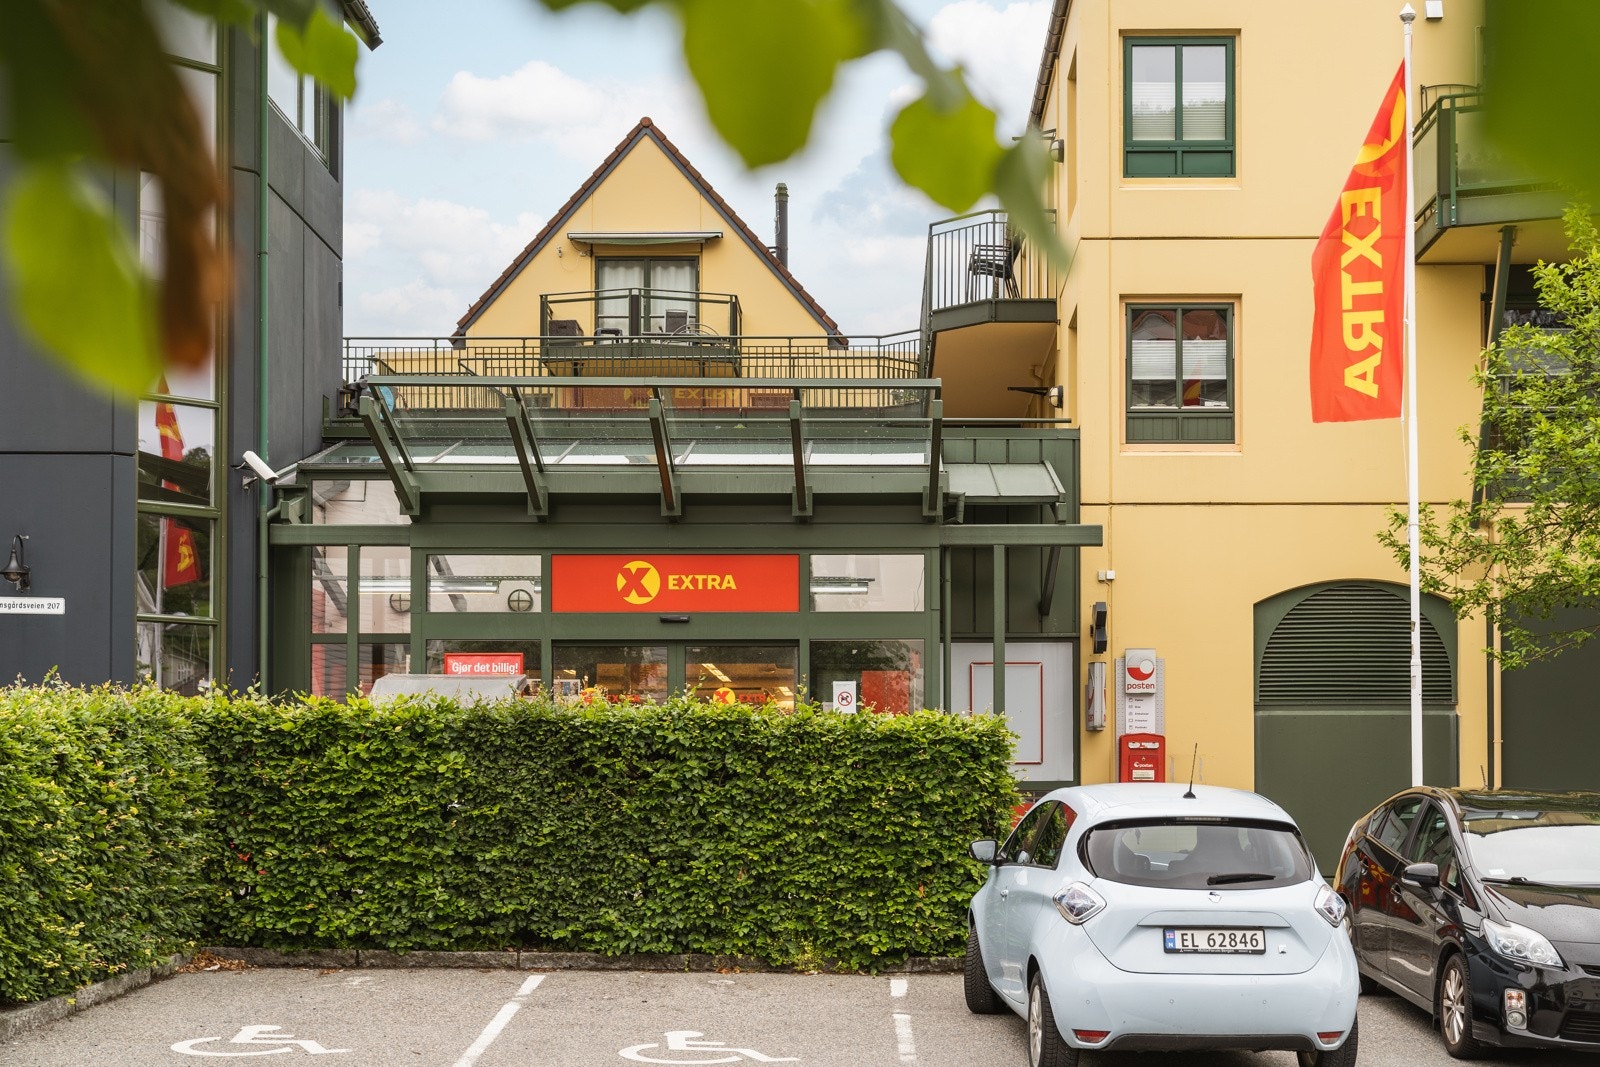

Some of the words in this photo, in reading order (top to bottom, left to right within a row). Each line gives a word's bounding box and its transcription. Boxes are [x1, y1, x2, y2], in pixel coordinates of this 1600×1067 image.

[668, 574, 737, 590] EXTRA
[47, 602, 61, 610] 207
[451, 662, 472, 674] Gjør
[473, 662, 490, 673] det
[491, 662, 519, 675] billig!
[1126, 682, 1155, 691] posten
[738, 693, 769, 703] EXTR
[1180, 933, 1199, 948] EL
[1207, 933, 1259, 948] 62846
